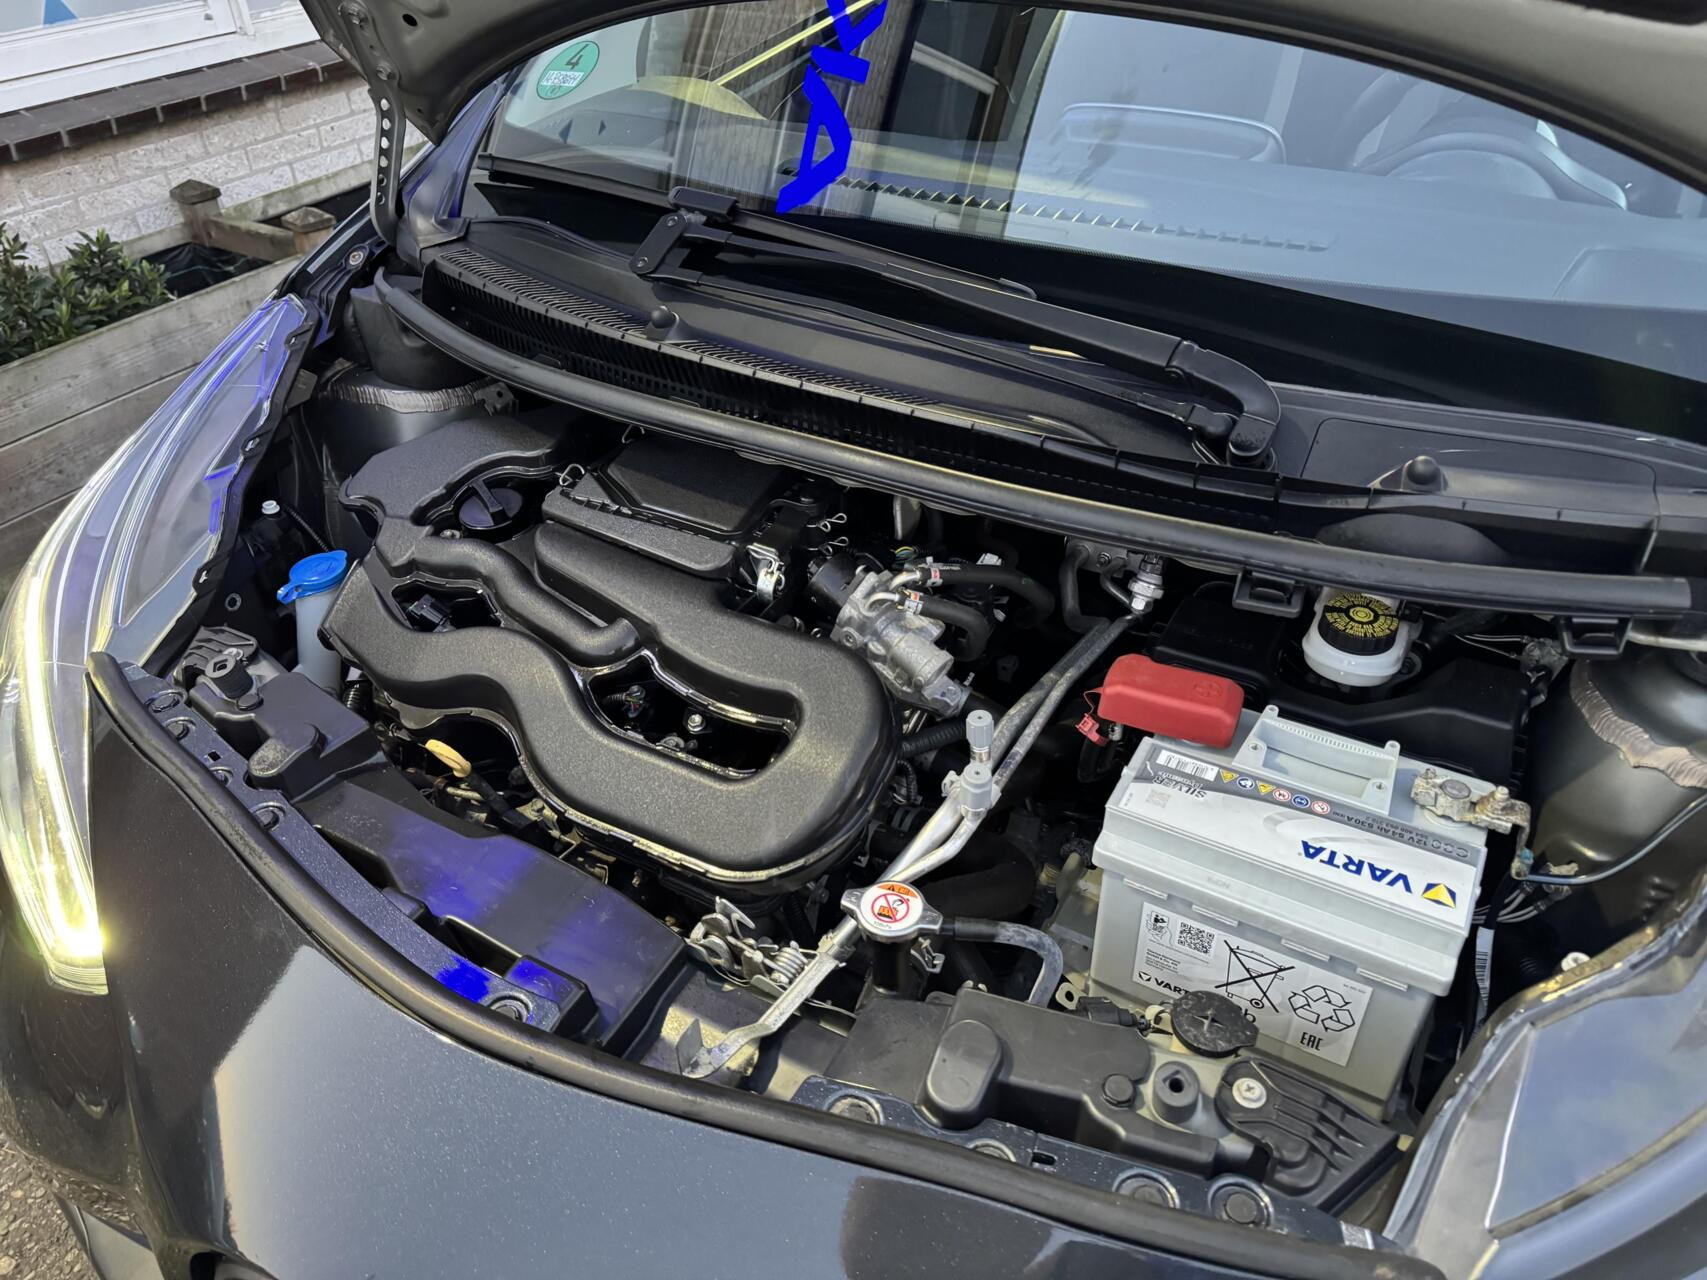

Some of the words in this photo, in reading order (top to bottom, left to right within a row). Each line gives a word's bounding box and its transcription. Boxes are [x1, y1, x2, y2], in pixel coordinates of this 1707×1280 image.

[565, 44, 590, 70] 4
[1153, 775, 1207, 798] SILVER
[1408, 835, 1427, 846] 12V
[1301, 840, 1413, 894] VARTA
[1154, 977, 1191, 995] VART
